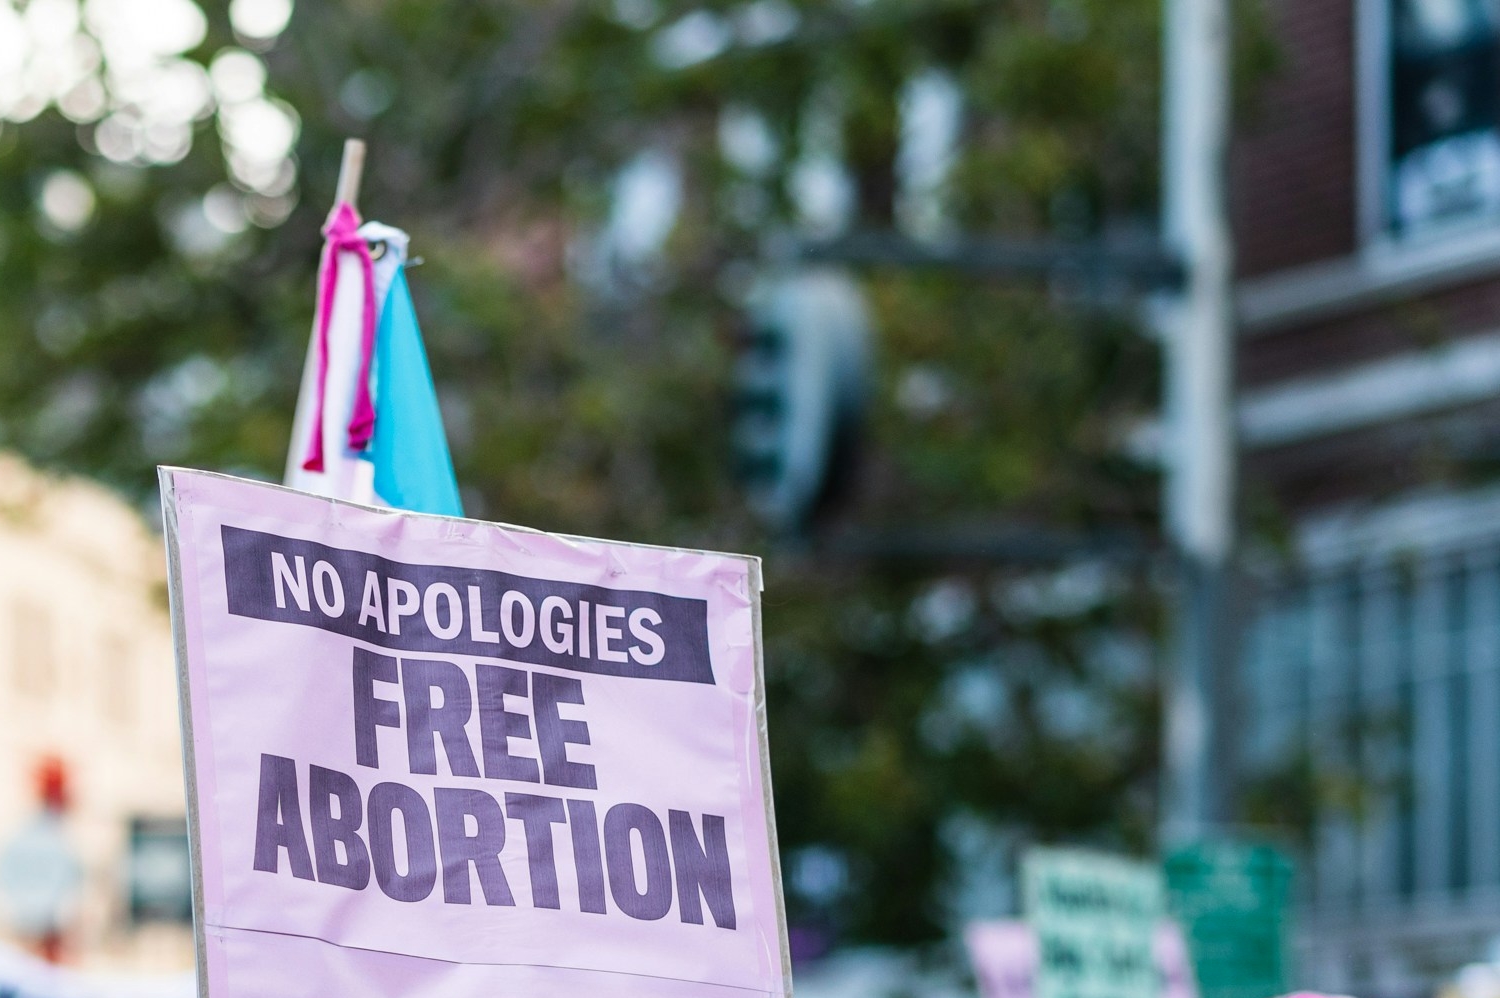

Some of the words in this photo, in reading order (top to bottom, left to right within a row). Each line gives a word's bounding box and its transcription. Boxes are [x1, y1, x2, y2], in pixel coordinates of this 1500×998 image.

[271, 553, 345, 618] NO
[358, 571, 666, 665] APOLOGIES
[352, 647, 598, 790] FREE
[253, 753, 737, 931] ABORTION
